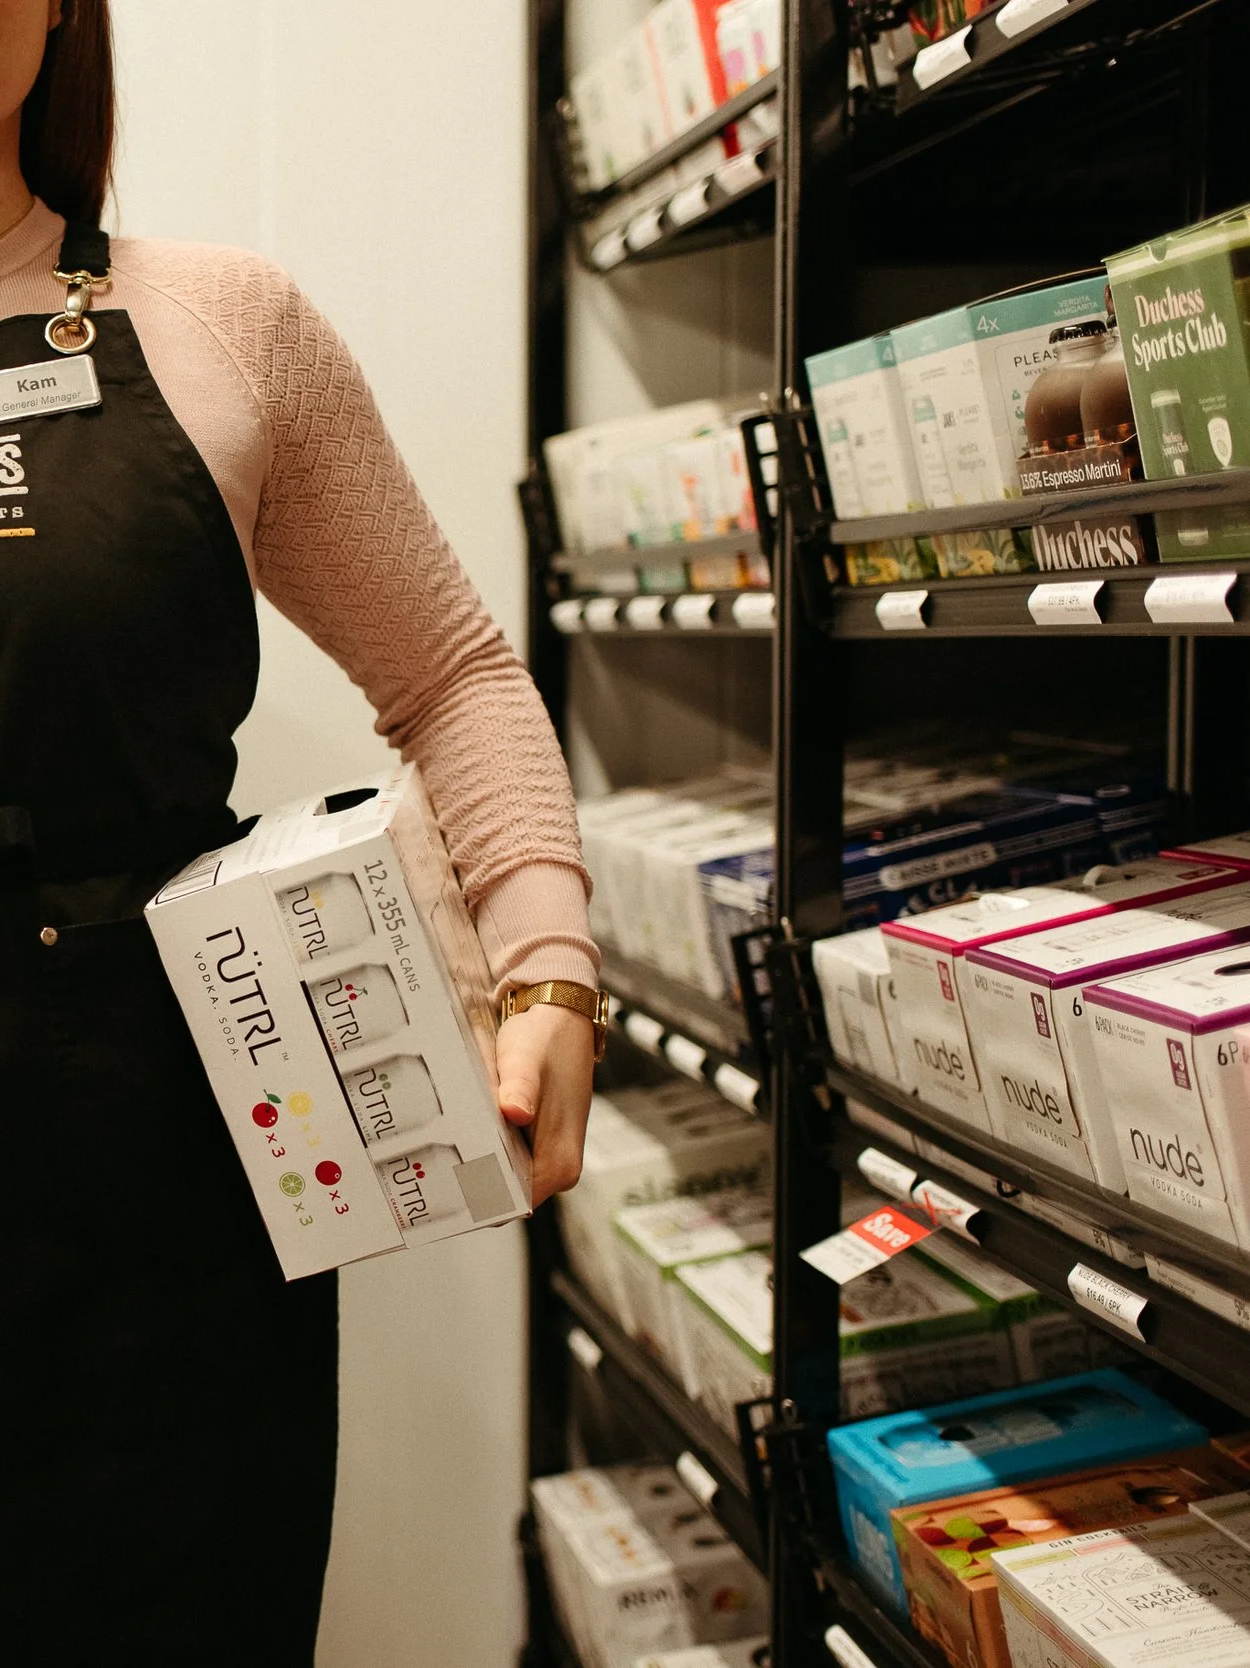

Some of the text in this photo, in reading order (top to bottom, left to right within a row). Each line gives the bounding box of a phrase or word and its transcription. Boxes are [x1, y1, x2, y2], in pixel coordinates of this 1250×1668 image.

[1135, 286, 1205, 328] Duchess
[976, 315, 1000, 333] 4x
[1132, 312, 1227, 372] Sports Club
[16, 376, 57, 393] Kam
[2, 391, 82, 412] General Manager
[1042, 467, 1085, 490] Espresso
[1085, 459, 1122, 481] Martini
[1032, 520, 1138, 571] Duchess
[363, 858, 421, 993] 12 x 355 mL CANS
[914, 1038, 965, 1081] nude
[1001, 1076, 1062, 1125] nude
[266, 1132, 287, 1159] x 3
[1130, 1128, 1204, 1187] nude
[329, 1190, 350, 1216] x 3
[1150, 1176, 1203, 1208] VODKA SODA
[293, 1202, 314, 1228] x 3
[862, 1213, 911, 1249] Save
[1092, 1275, 1109, 1290] BLACK
[1108, 1283, 1131, 1299] CHERRY
[1048, 1524, 1148, 1550] GIN COCKTAILS
[1125, 1584, 1197, 1604] STRAIT
[1134, 1588, 1219, 1612] NARROW
